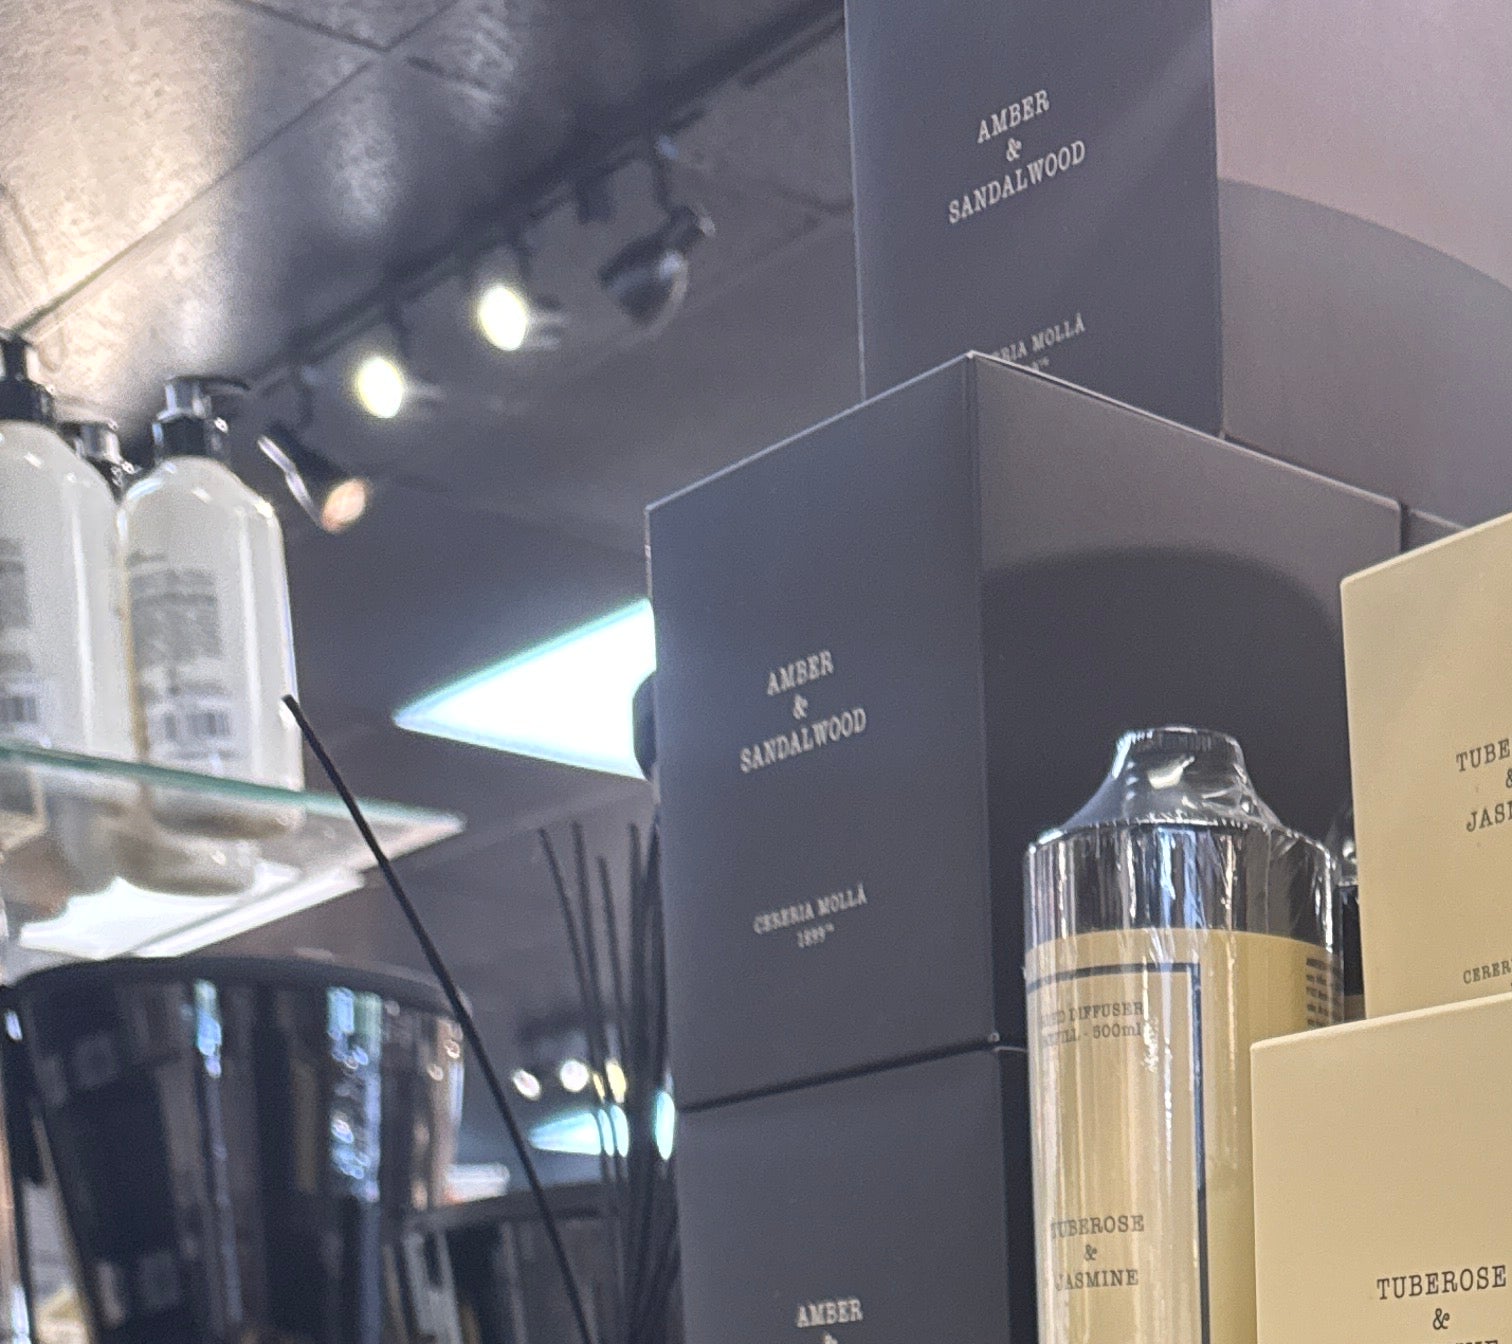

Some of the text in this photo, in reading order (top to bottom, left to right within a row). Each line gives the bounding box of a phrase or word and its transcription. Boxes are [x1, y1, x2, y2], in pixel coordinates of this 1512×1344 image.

[977, 89, 1050, 144] AMBER
[1006, 137, 1022, 162] &
[949, 140, 1086, 224] SANDALWOOD
[767, 650, 834, 696] AMBER
[793, 694, 808, 720] &
[740, 708, 867, 773] SANDALWOOD
[1069, 1001, 1144, 1022] DIFFUSER
[1084, 1244, 1098, 1261] &
[1055, 1269, 1139, 1292] JASMINE
[1376, 1265, 1506, 1300] TUBEROSE
[796, 1298, 863, 1328] AMBER
[1432, 1308, 1450, 1330] &
